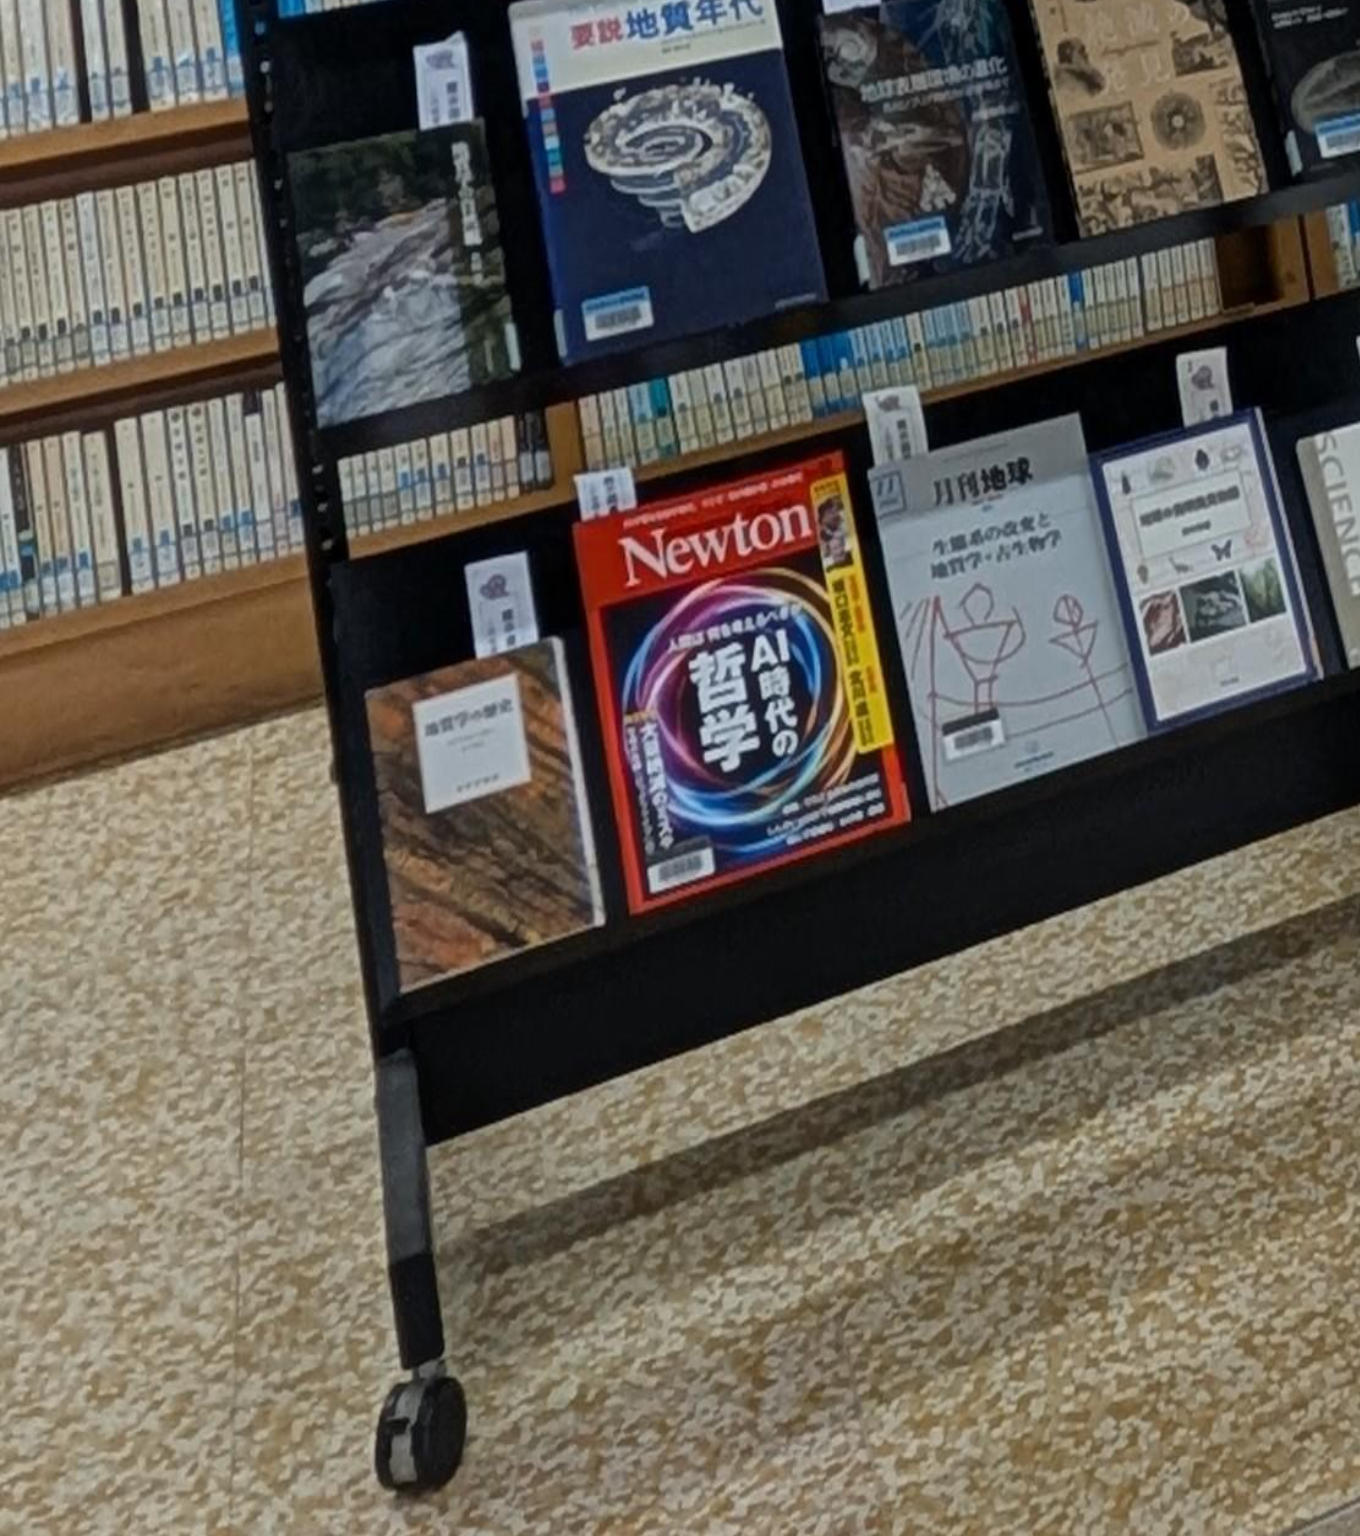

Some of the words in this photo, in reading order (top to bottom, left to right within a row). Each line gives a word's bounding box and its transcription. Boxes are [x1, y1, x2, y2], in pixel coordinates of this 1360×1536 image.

[934, 456, 1033, 506] 月刊地球
[618, 504, 813, 587] Newton
[688, 642, 760, 773] 哲学
[751, 628, 798, 758] AI時代の
